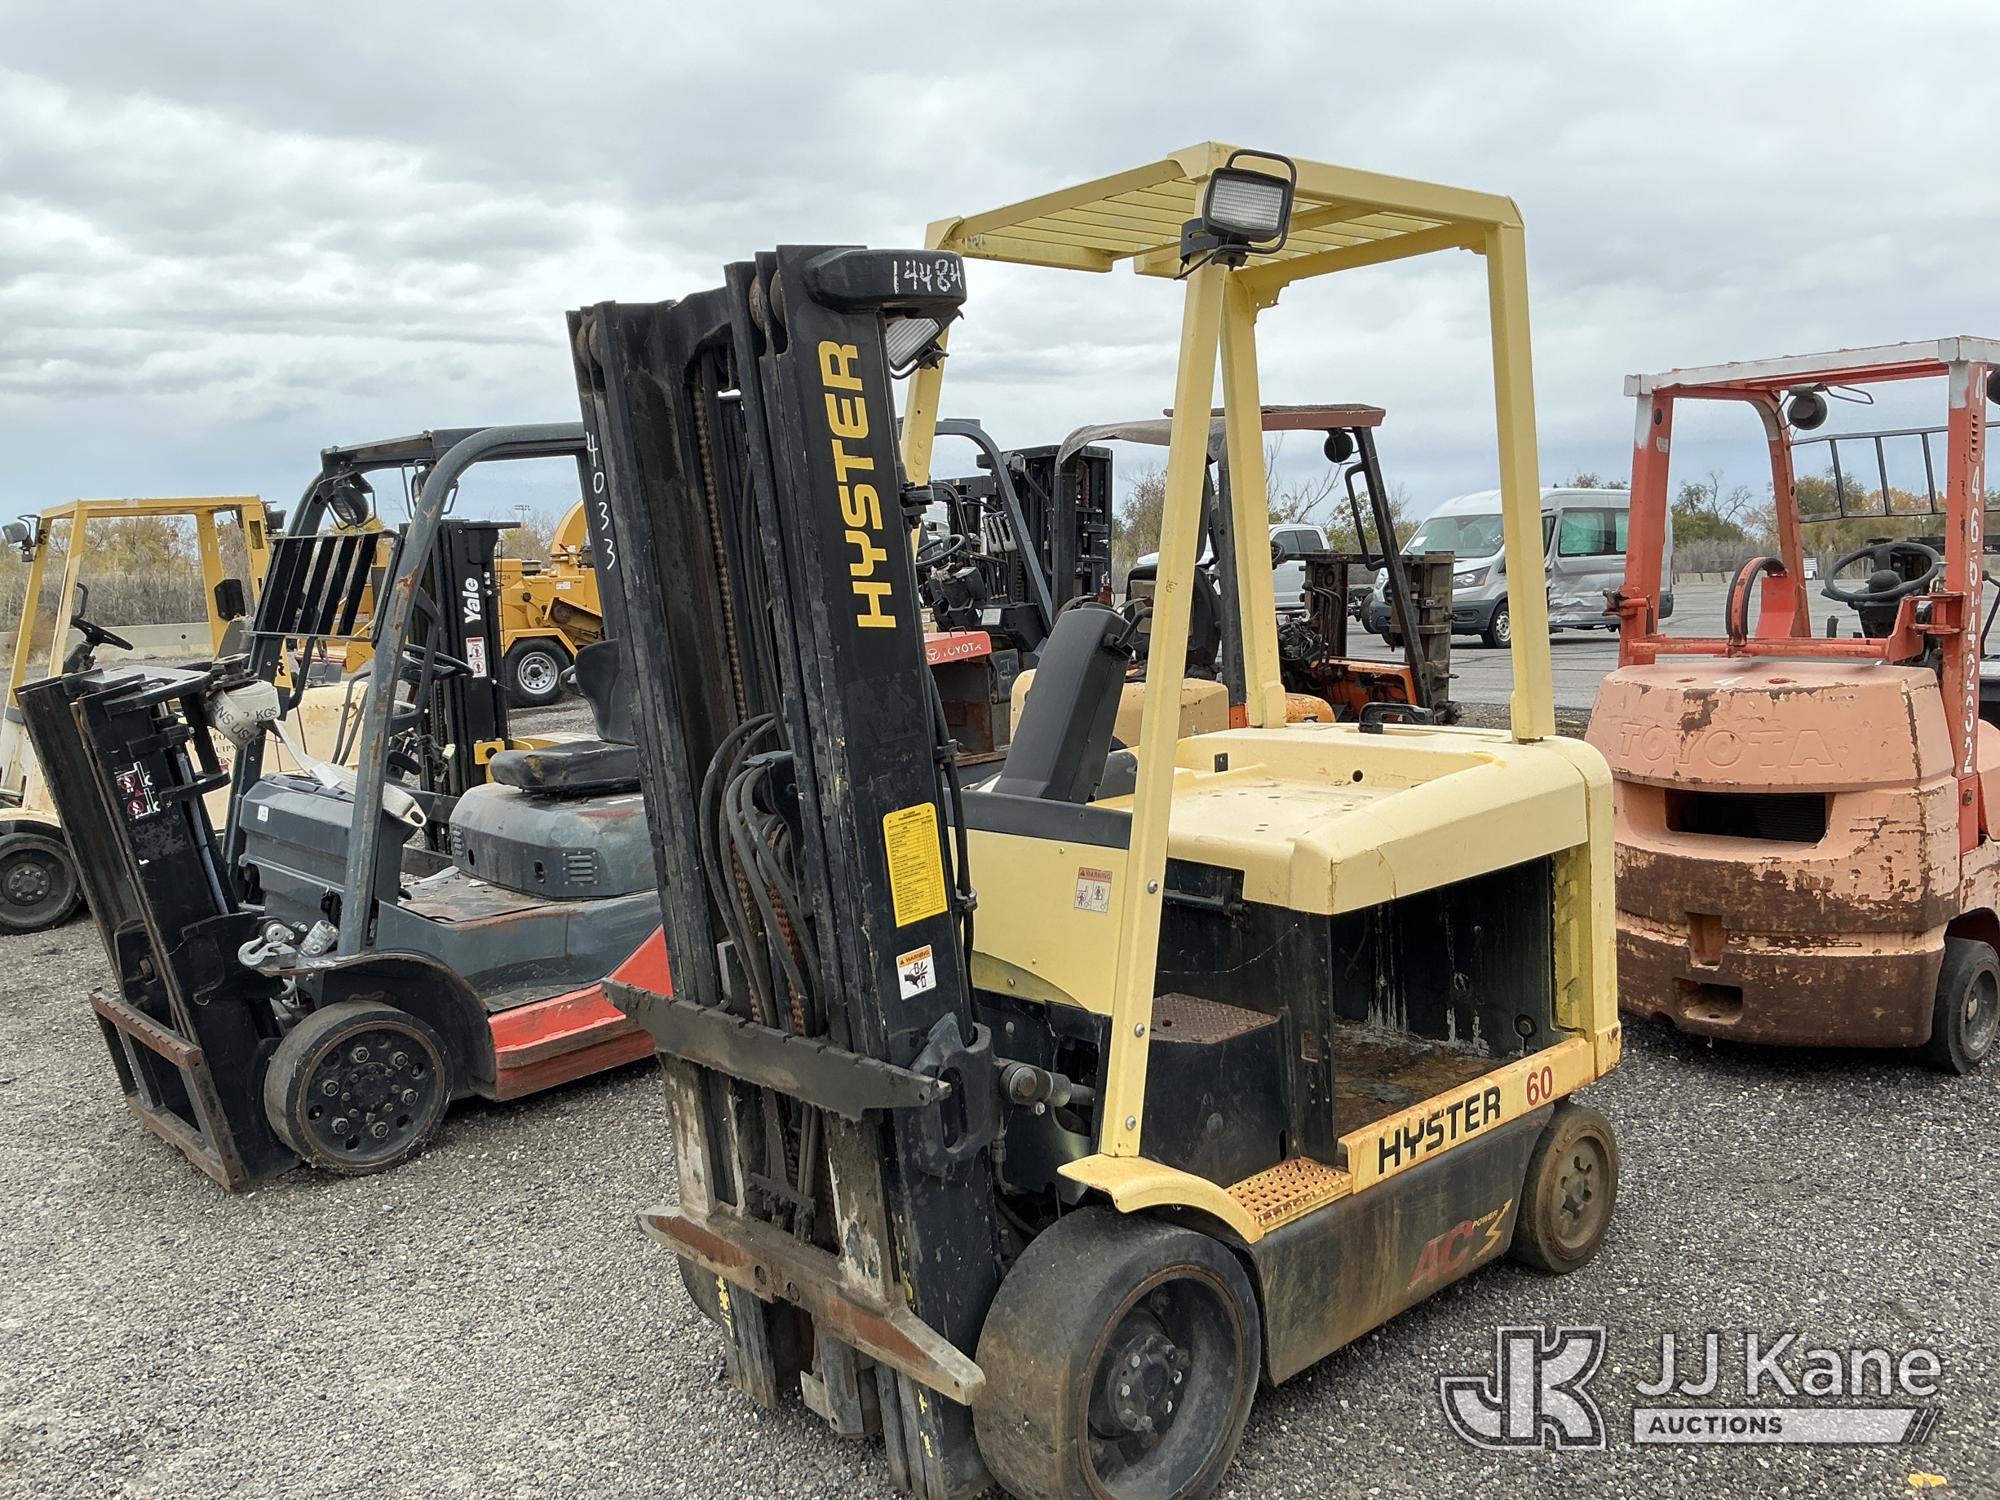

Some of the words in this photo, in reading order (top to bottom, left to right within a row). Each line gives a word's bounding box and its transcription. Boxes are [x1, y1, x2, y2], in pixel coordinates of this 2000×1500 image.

[893, 259, 963, 294] 14484
[586, 431, 616, 570] 4033
[817, 339, 897, 629] HYSTER
[462, 577, 482, 624] Yale
[943, 642, 982, 657] OYOTA
[255, 707, 278, 720] KGS
[1618, 720, 1836, 767] TOYOTA
[905, 949, 931, 962] WARNING
[1378, 1086, 1501, 1175] HYSTER
[1526, 1065, 1553, 1106] 60
